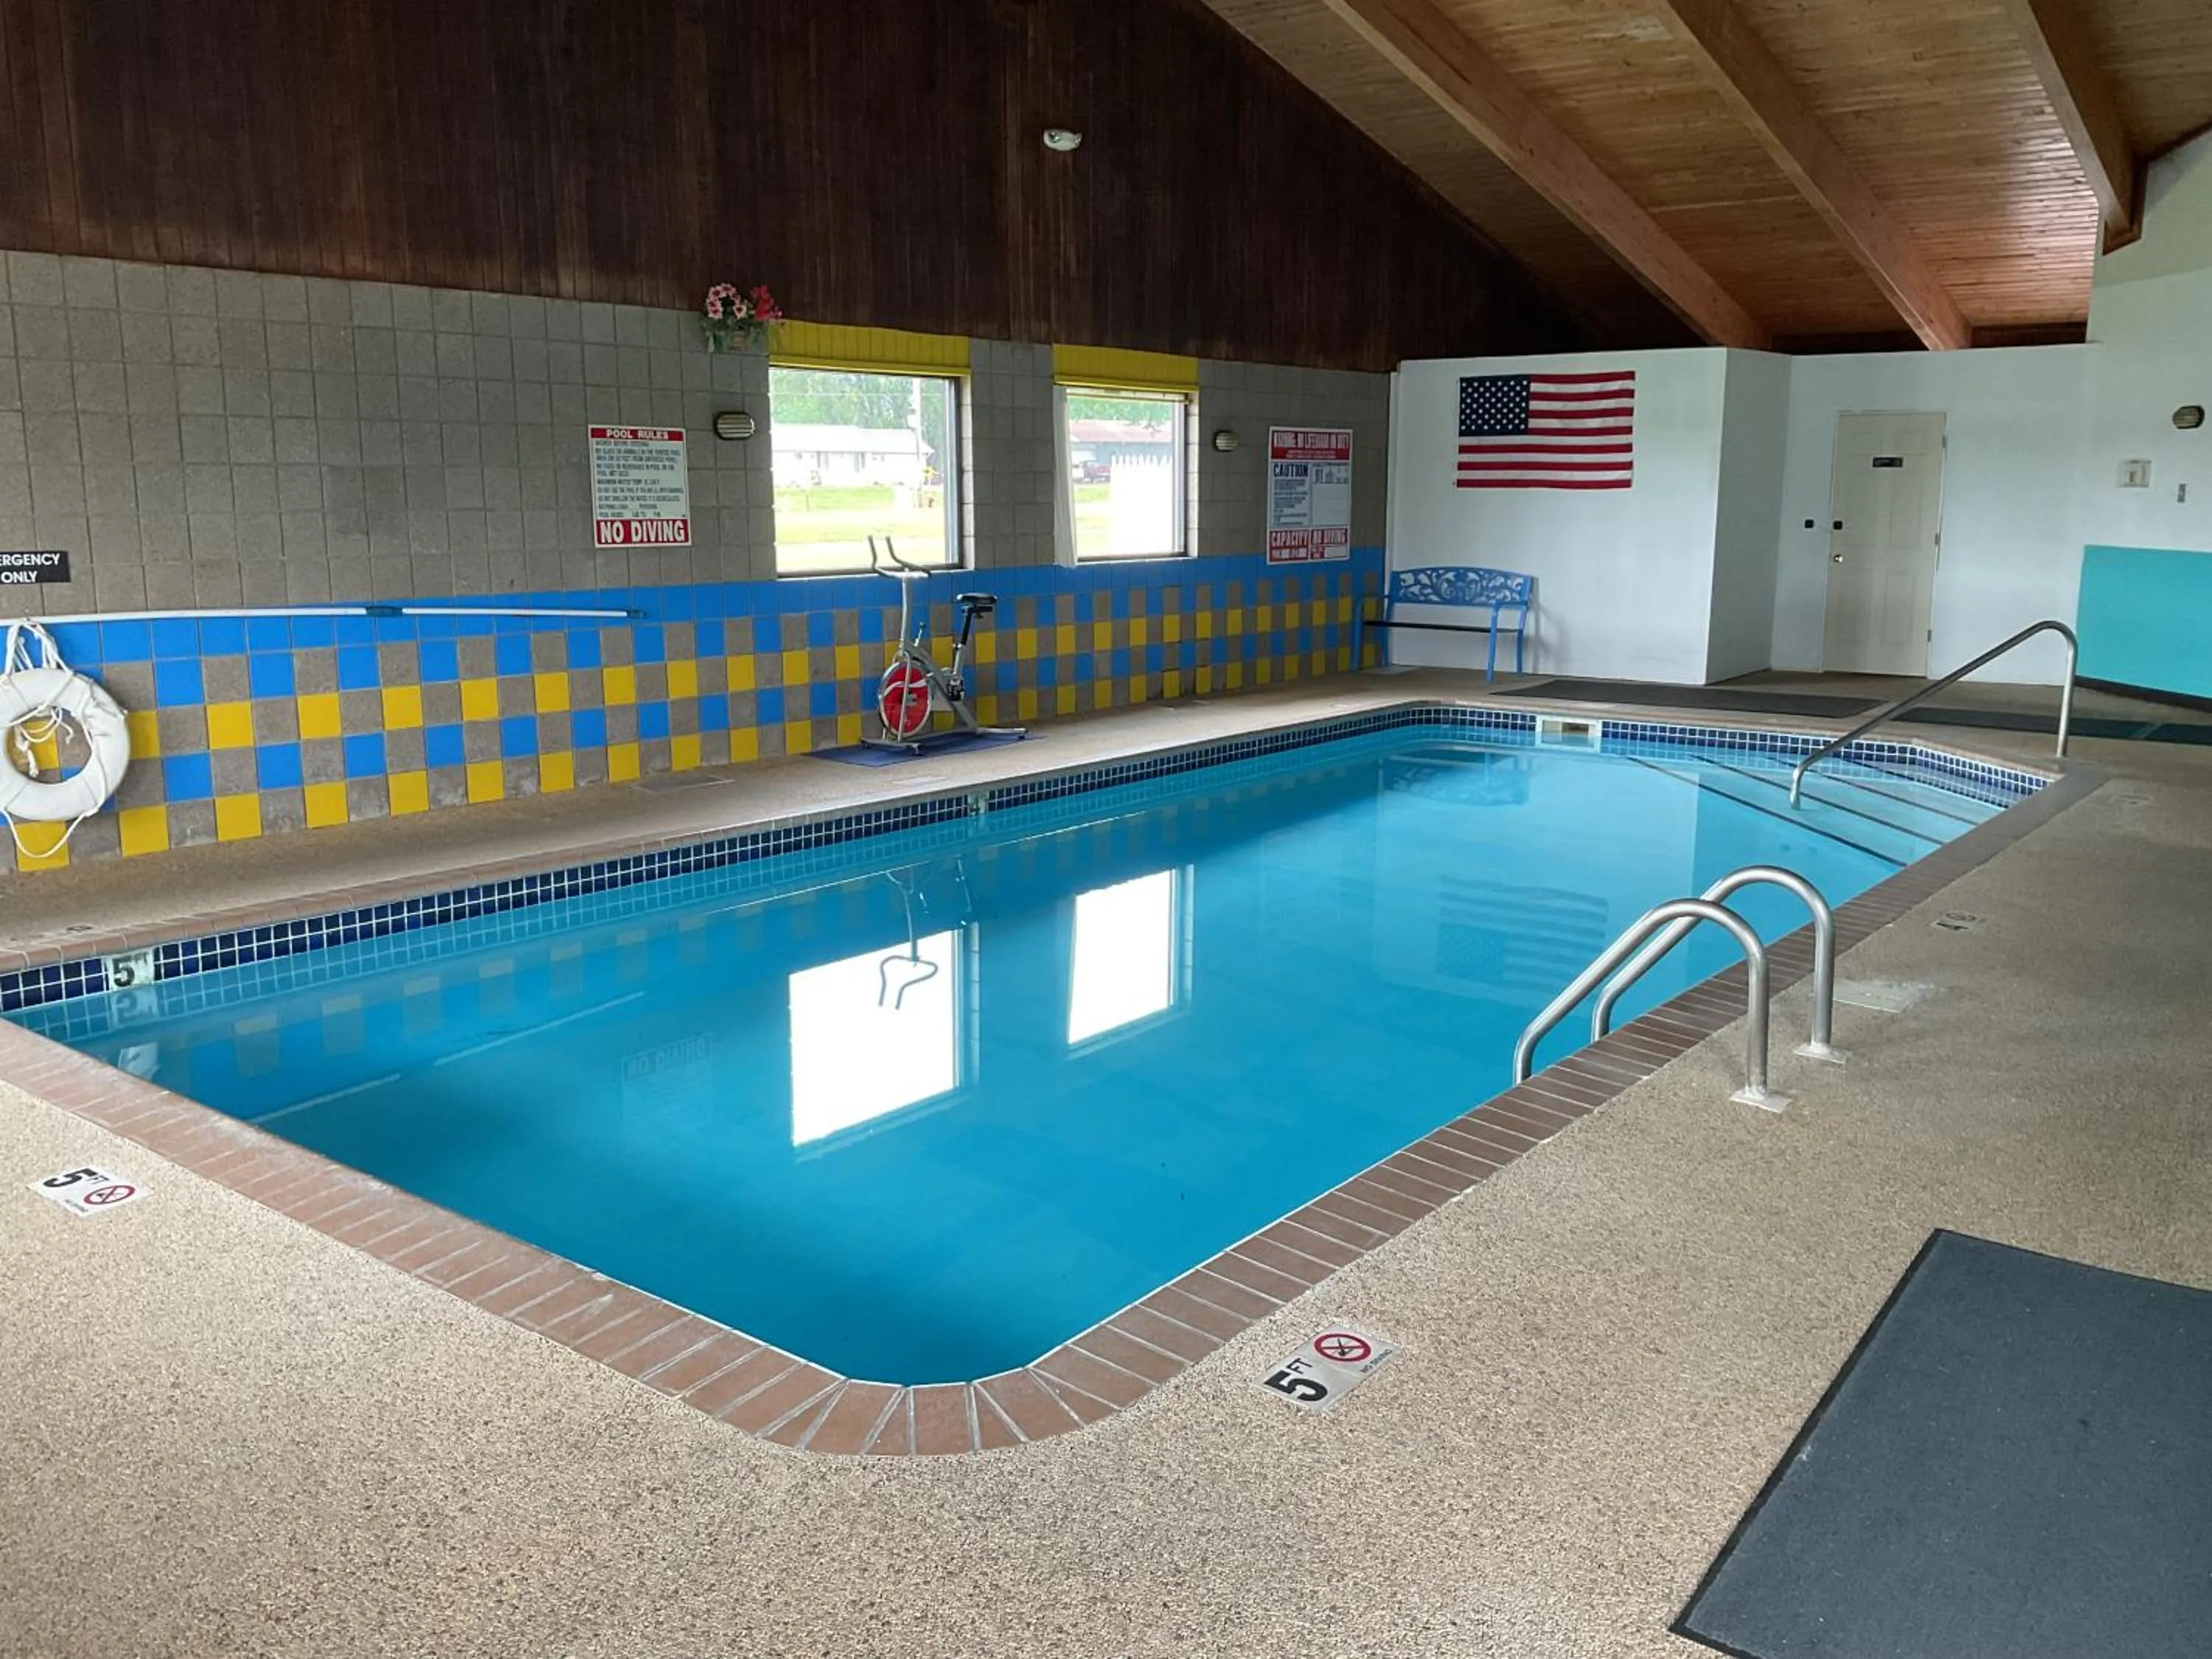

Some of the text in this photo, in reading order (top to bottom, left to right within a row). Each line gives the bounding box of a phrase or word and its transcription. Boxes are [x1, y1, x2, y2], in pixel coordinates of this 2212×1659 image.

[606, 428, 669, 440] POOL RULES
[599, 520, 685, 543] NO DIVING
[0, 553, 60, 566] RGENCY
[1, 570, 38, 583] ONLY
[112, 956, 135, 987] 5
[43, 1167, 98, 1188] 5
[1263, 1357, 1328, 1402] 5 FT
